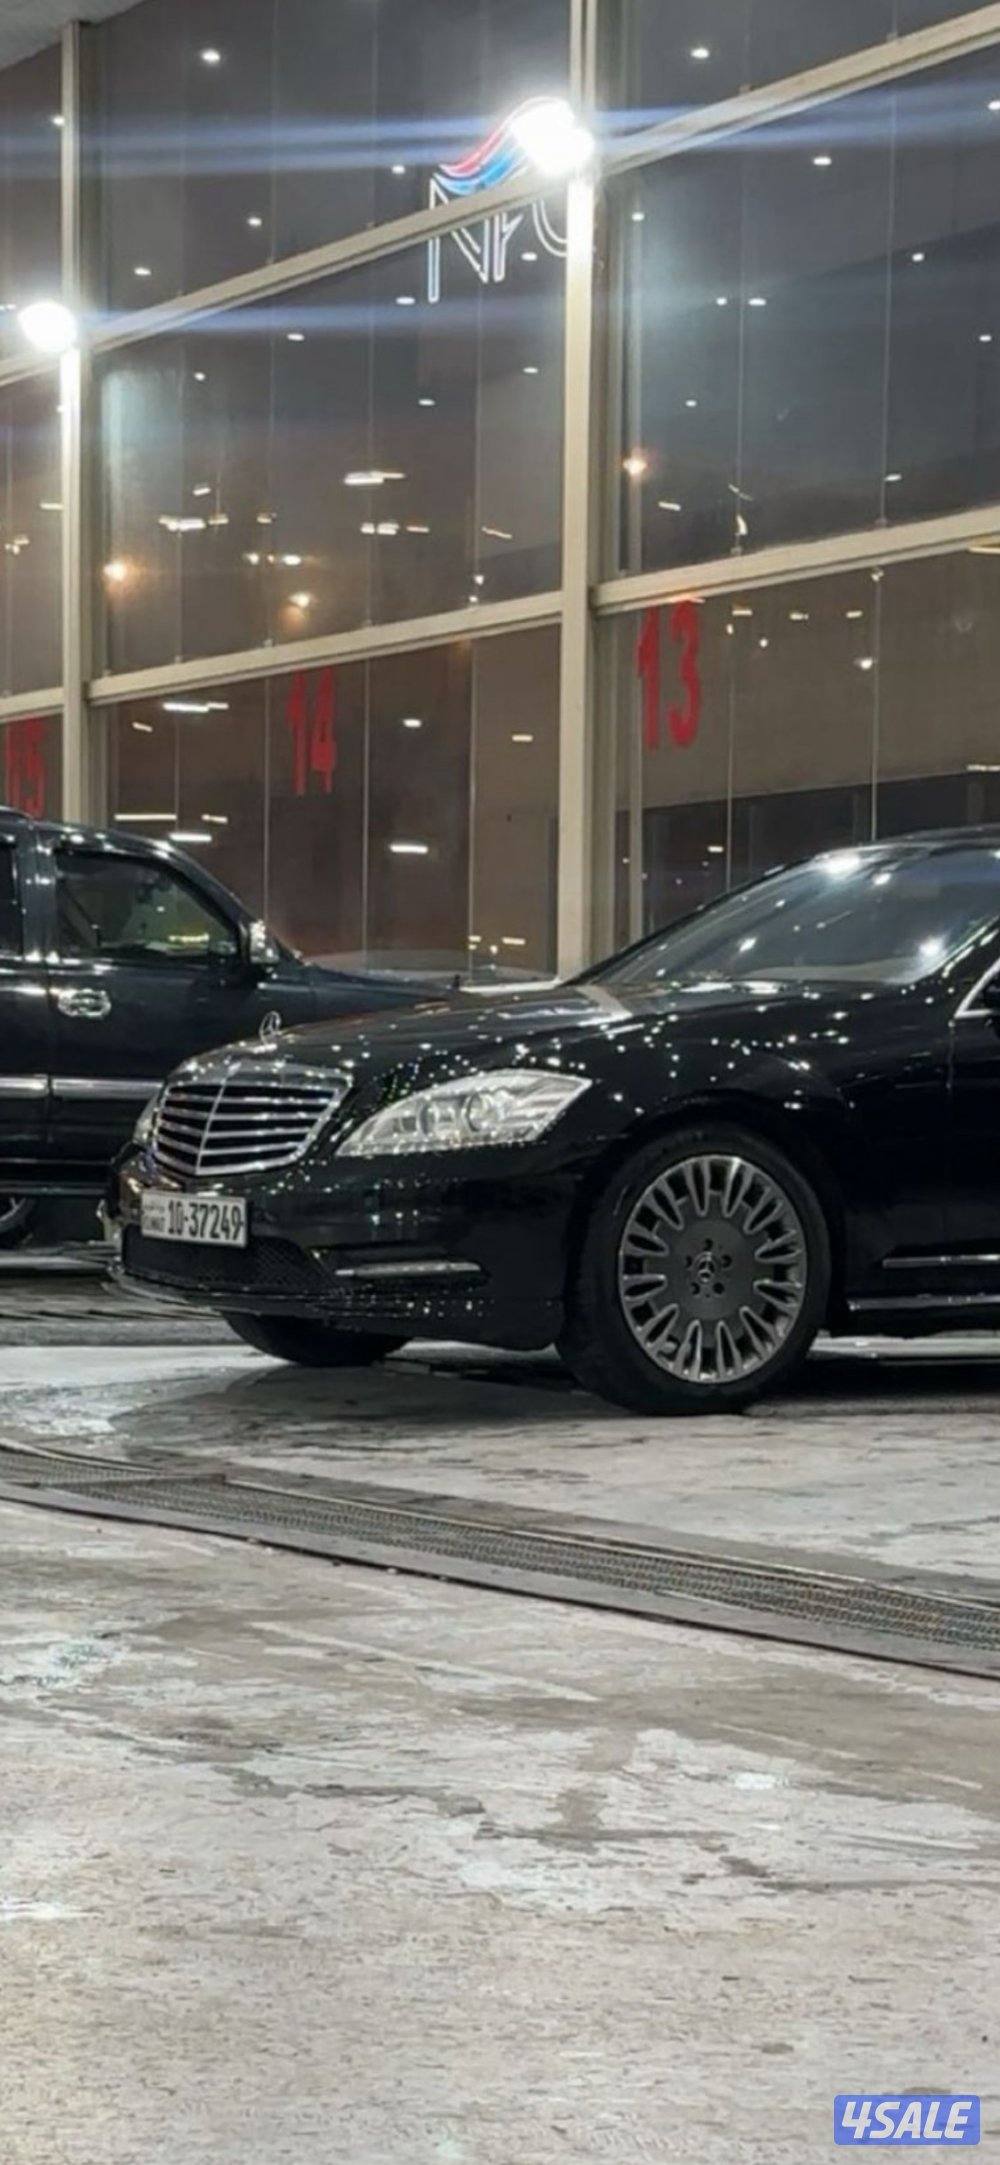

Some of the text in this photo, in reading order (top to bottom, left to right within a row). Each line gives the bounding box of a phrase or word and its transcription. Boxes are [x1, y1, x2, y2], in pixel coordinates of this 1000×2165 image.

[286, 664, 337, 796] 14
[635, 600, 701, 757] 13
[168, 1200, 242, 1241] 10-37249
